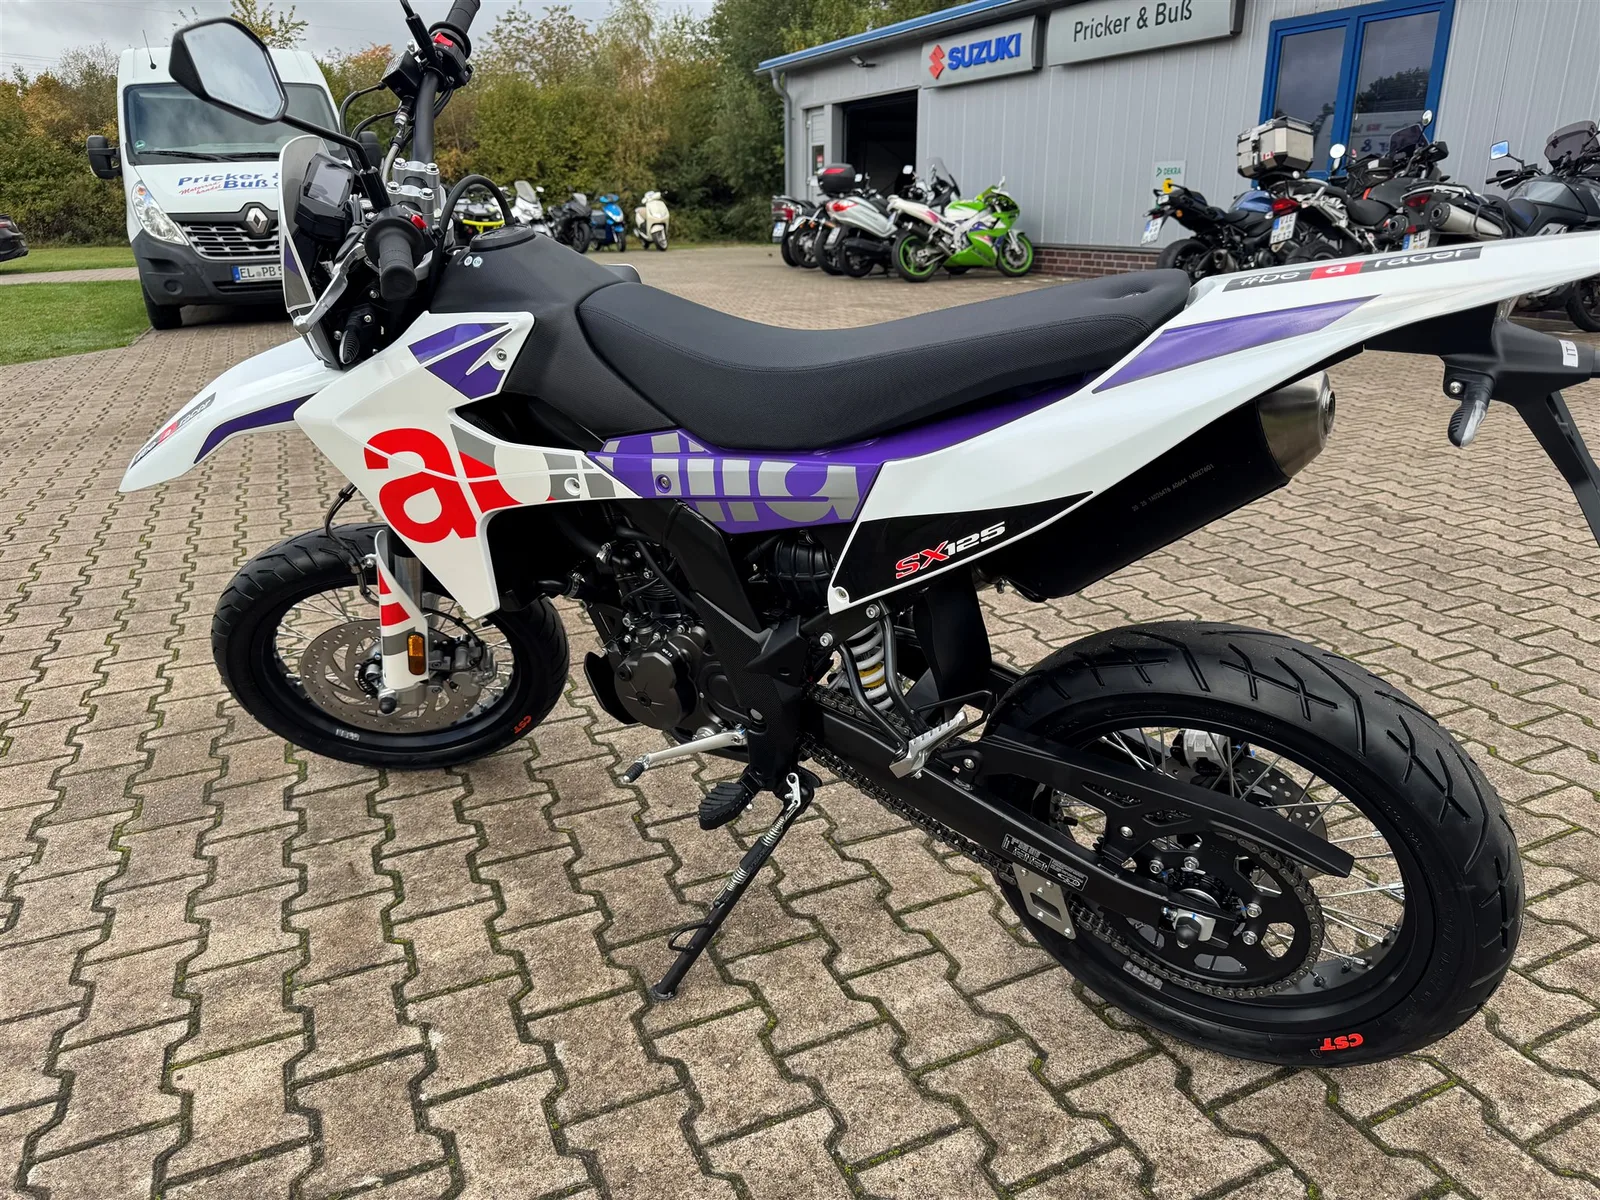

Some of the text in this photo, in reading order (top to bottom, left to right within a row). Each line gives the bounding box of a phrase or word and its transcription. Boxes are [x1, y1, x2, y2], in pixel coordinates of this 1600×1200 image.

[1073, 0, 1192, 42] Pricker & Buß
[947, 32, 1022, 70] SUZUKI
[178, 173, 264, 187] Pricker
[1163, 167, 1182, 176] DEKRA
[223, 179, 268, 189] Buß
[240, 267, 255, 279] EL
[261, 266, 276, 277] PB
[1239, 248, 1471, 287] #be a racer
[895, 521, 1006, 580] SX125
[513, 715, 532, 734] CST
[1319, 1033, 1364, 1051] CST
